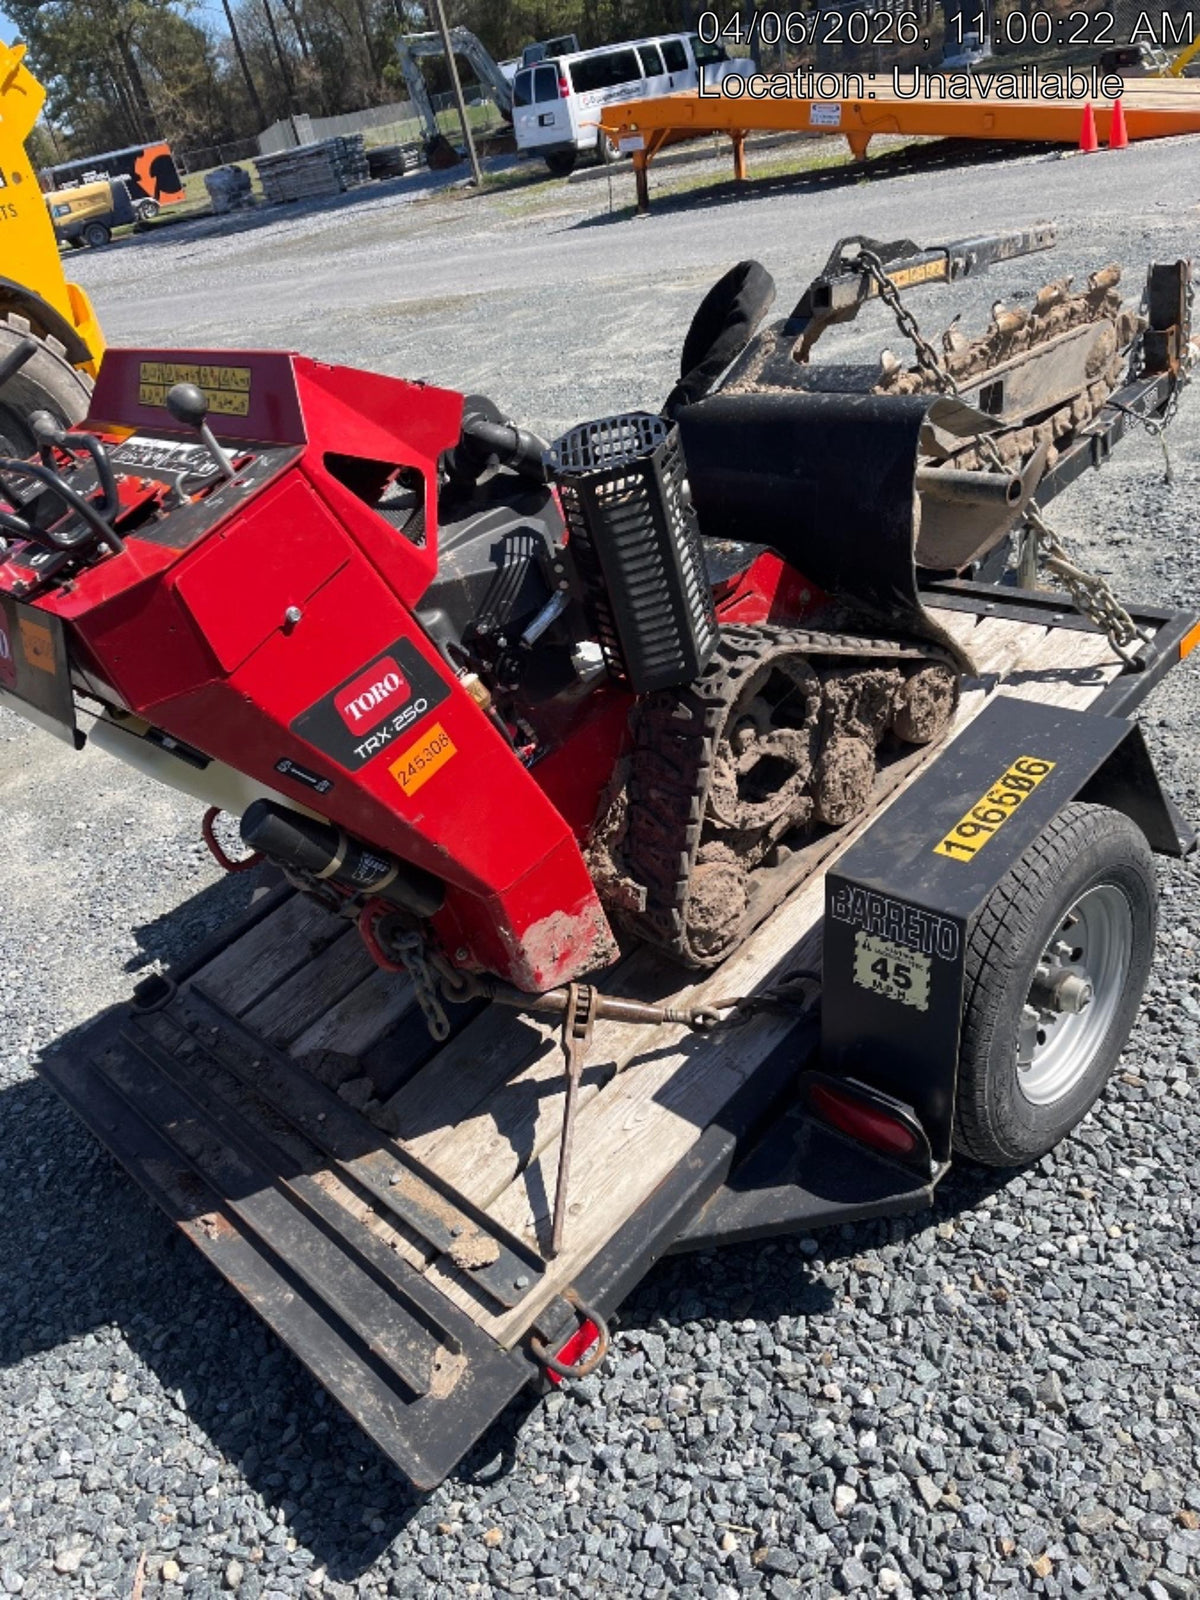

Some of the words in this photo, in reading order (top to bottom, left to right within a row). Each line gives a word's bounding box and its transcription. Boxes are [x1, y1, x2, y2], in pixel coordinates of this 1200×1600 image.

[344, 672, 401, 721] TORO
[397, 733, 449, 787] 245308
[831, 885, 959, 962] BARRETO
[870, 957, 913, 990] 45
